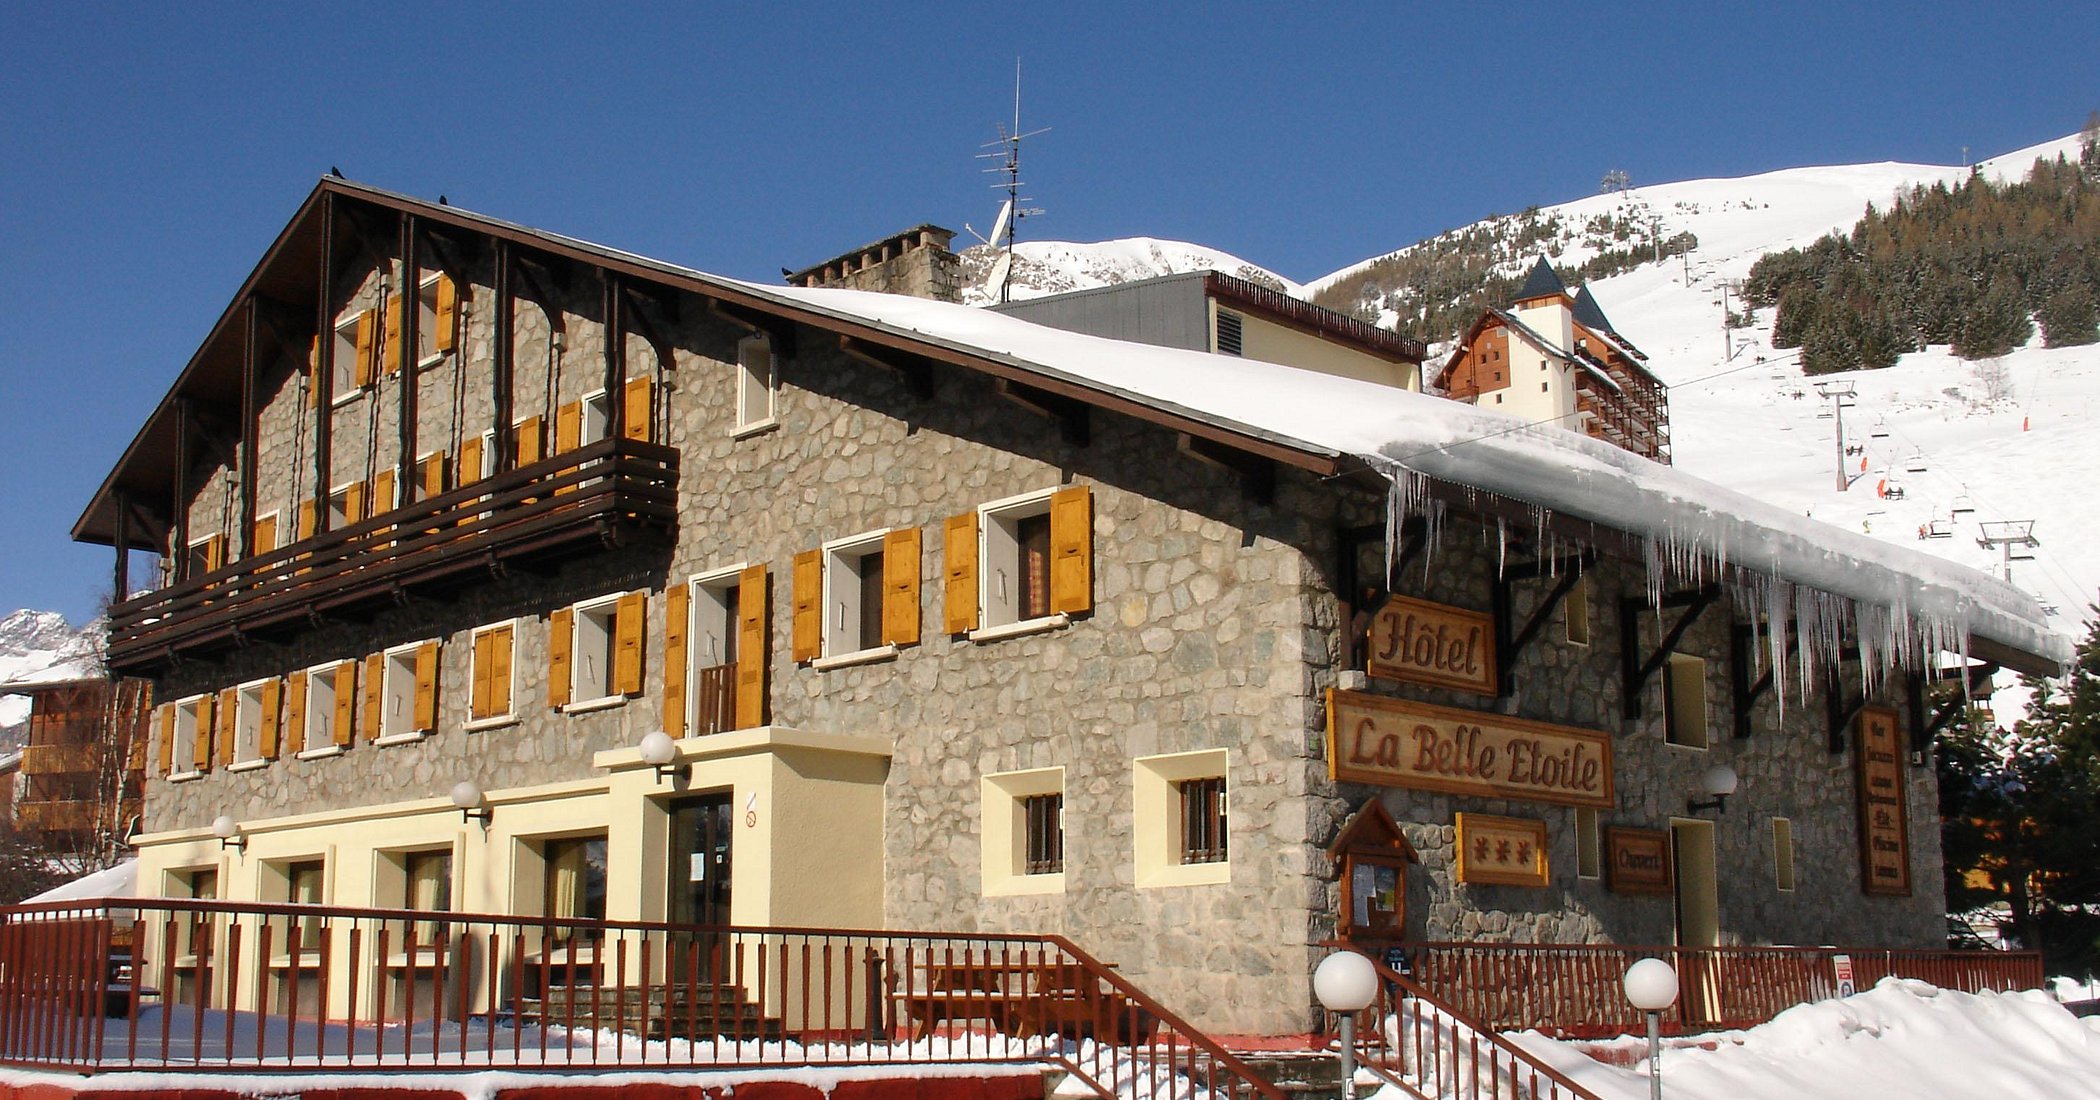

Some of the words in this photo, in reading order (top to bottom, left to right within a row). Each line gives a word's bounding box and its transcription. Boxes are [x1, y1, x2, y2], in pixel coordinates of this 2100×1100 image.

[1380, 612, 1480, 675] Hôtel
[1350, 717, 1399, 768] La
[1412, 724, 1496, 779] Belle
[1506, 738, 1599, 792] Etoile
